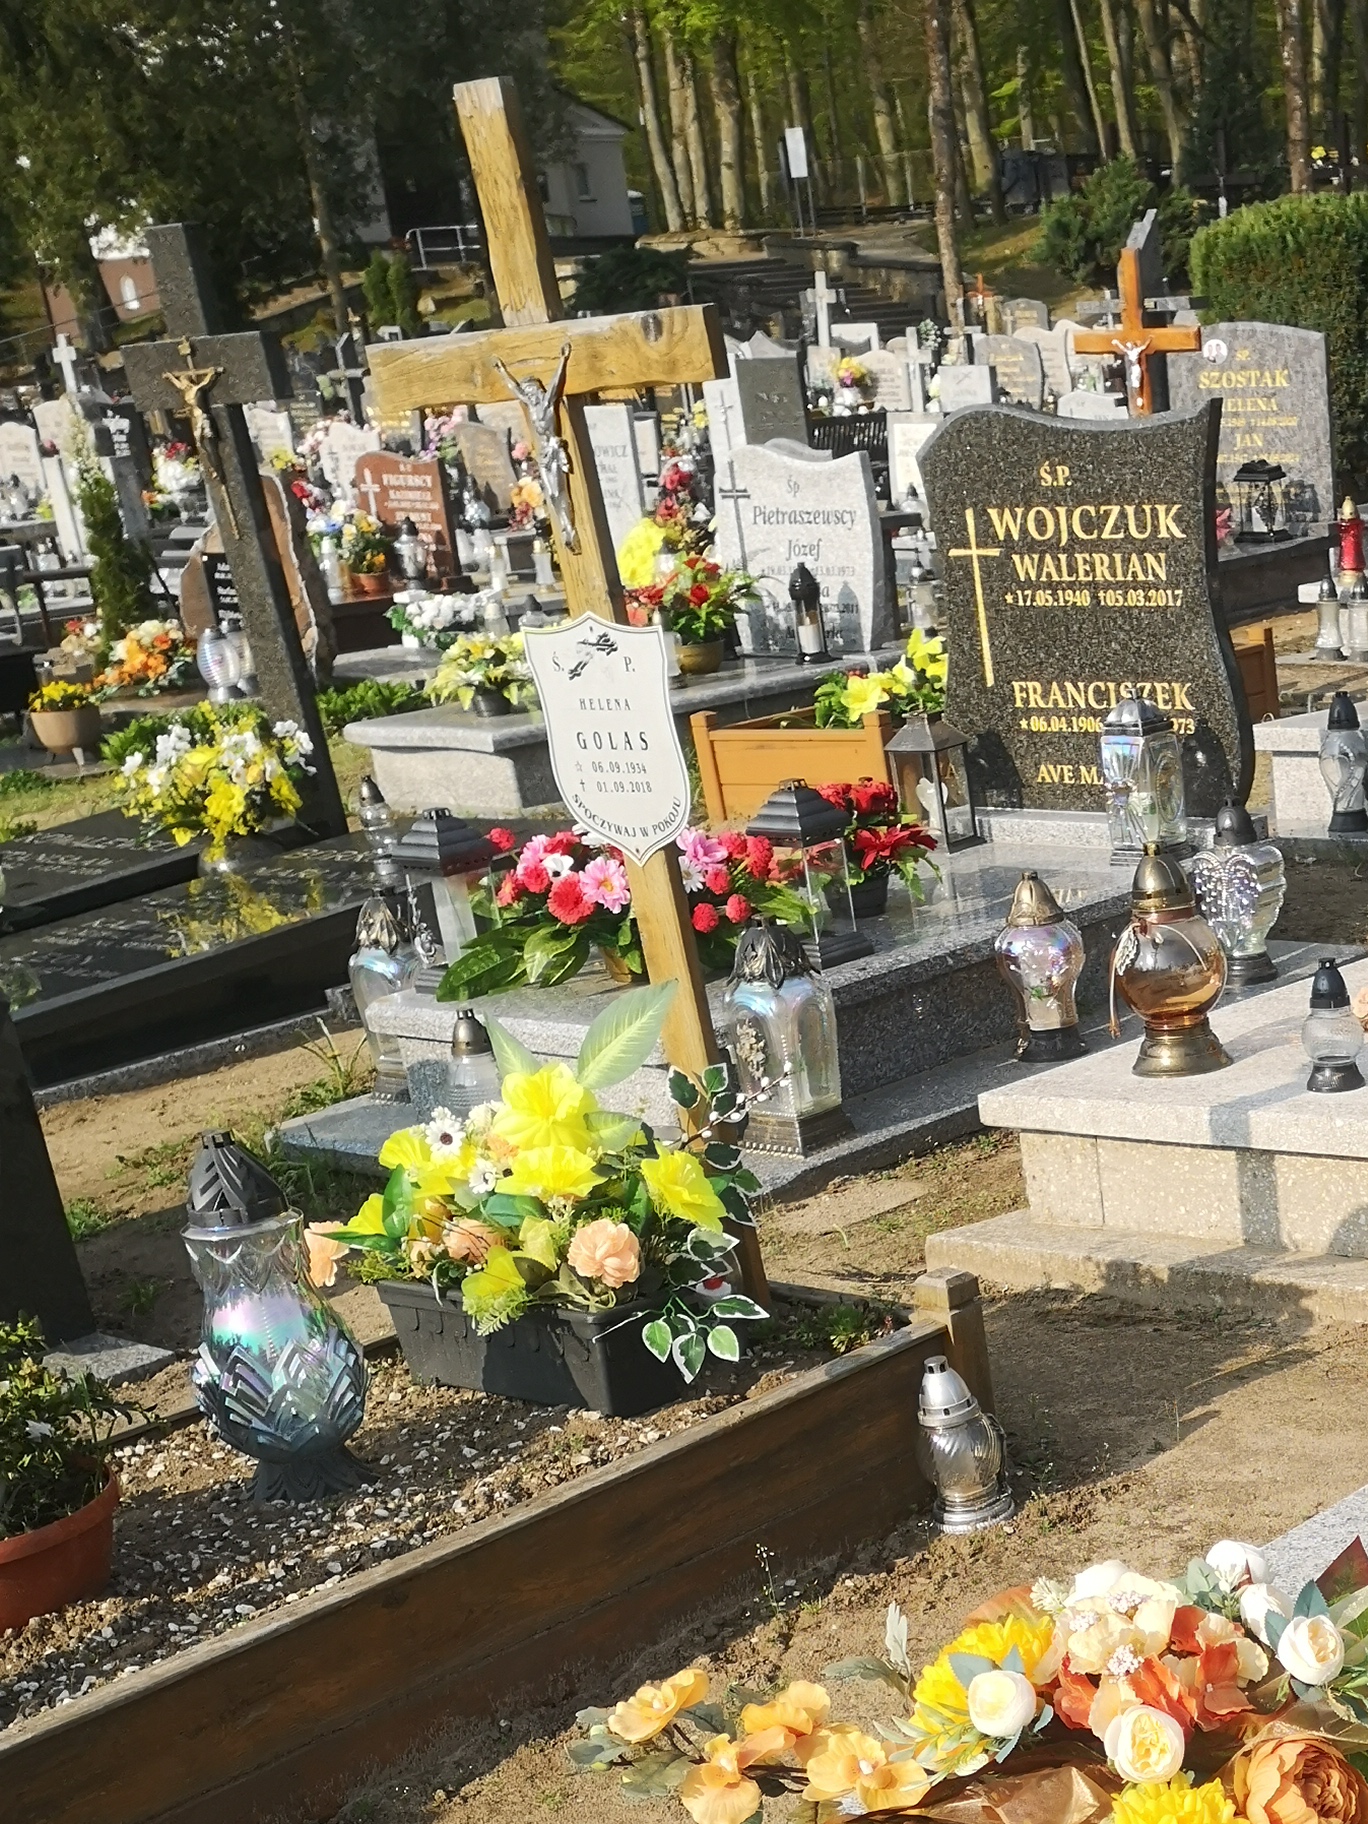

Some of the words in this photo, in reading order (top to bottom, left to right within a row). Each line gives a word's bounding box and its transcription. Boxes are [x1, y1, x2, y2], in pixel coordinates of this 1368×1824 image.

[1198, 369, 1290, 389] SZOSTAK
[1222, 398, 1278, 412] ELENA
[1234, 433, 1264, 450] JAN
[1039, 461, 1072, 487] Ś.P.
[752, 505, 857, 531] Pietraszewscy
[986, 504, 1187, 547] WOJCZUK
[786, 538, 823, 562] Józef
[1011, 552, 1168, 582] WALERIAN
[579, 698, 632, 711] HELENA
[576, 731, 649, 751] GOLAS
[1037, 764, 1075, 785] AVE
[572, 793, 637, 838] SPOCZYWAJ
[639, 827, 650, 838] W
[652, 797, 683, 834] POKOJU
